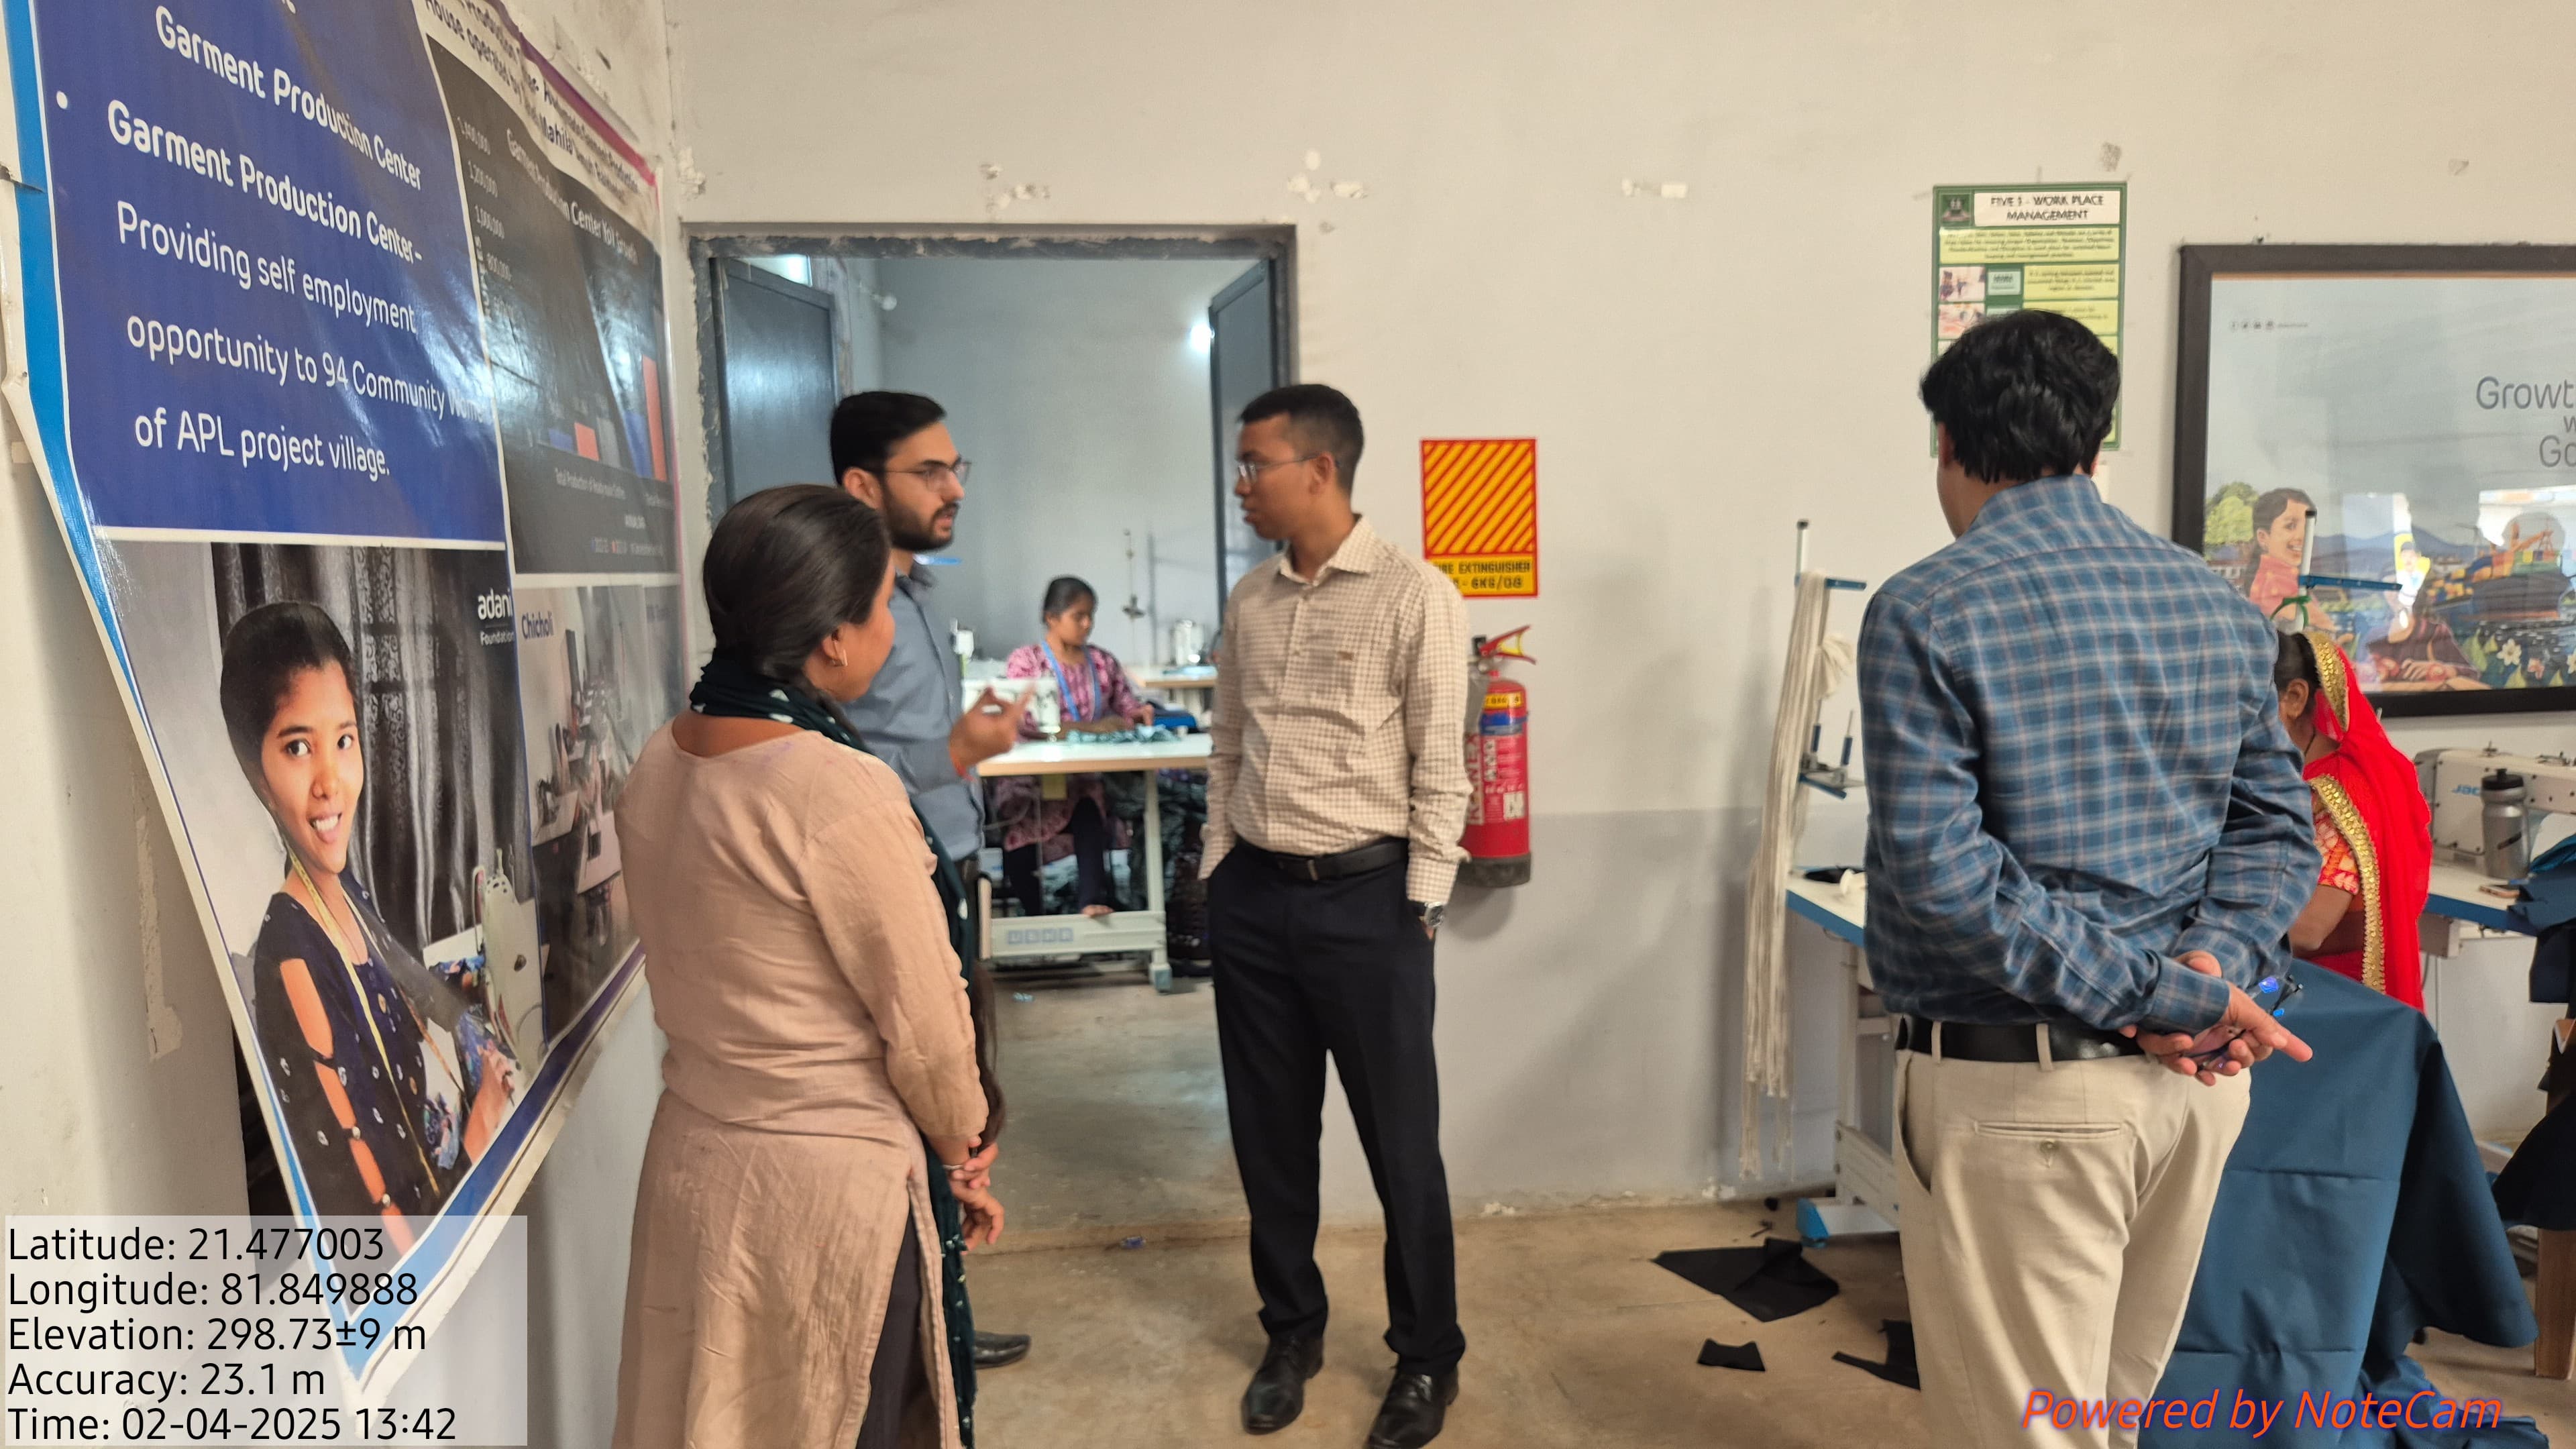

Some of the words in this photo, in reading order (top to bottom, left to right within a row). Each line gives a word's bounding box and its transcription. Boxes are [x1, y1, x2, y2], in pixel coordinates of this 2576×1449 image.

[156, 5, 266, 99] Garment
[274, 68, 374, 160] Production
[374, 135, 421, 191] Center
[107, 99, 233, 187] Garment
[239, 154, 362, 239] Production
[366, 210, 423, 264] Center-
[2033, 195, 2069, 206] WORK
[2071, 194, 2104, 206] PLACE
[570, 201, 602, 239] Center
[2006, 209, 2088, 221] MANAGEMENT
[117, 201, 251, 290] Providing
[258, 256, 296, 295] self
[303, 272, 417, 334] employment
[127, 315, 288, 386] opportunity
[294, 347, 317, 384] to
[322, 351, 348, 387] 94
[352, 360, 445, 421] Community
[135, 407, 167, 449] of
[177, 410, 235, 458] APL
[241, 425, 324, 472] project
[328, 433, 390, 482] village.
[1434, 562, 1454, 575] IRE
[1458, 559, 1531, 574] EXTINGUISHER
[478, 587, 514, 621] adani
